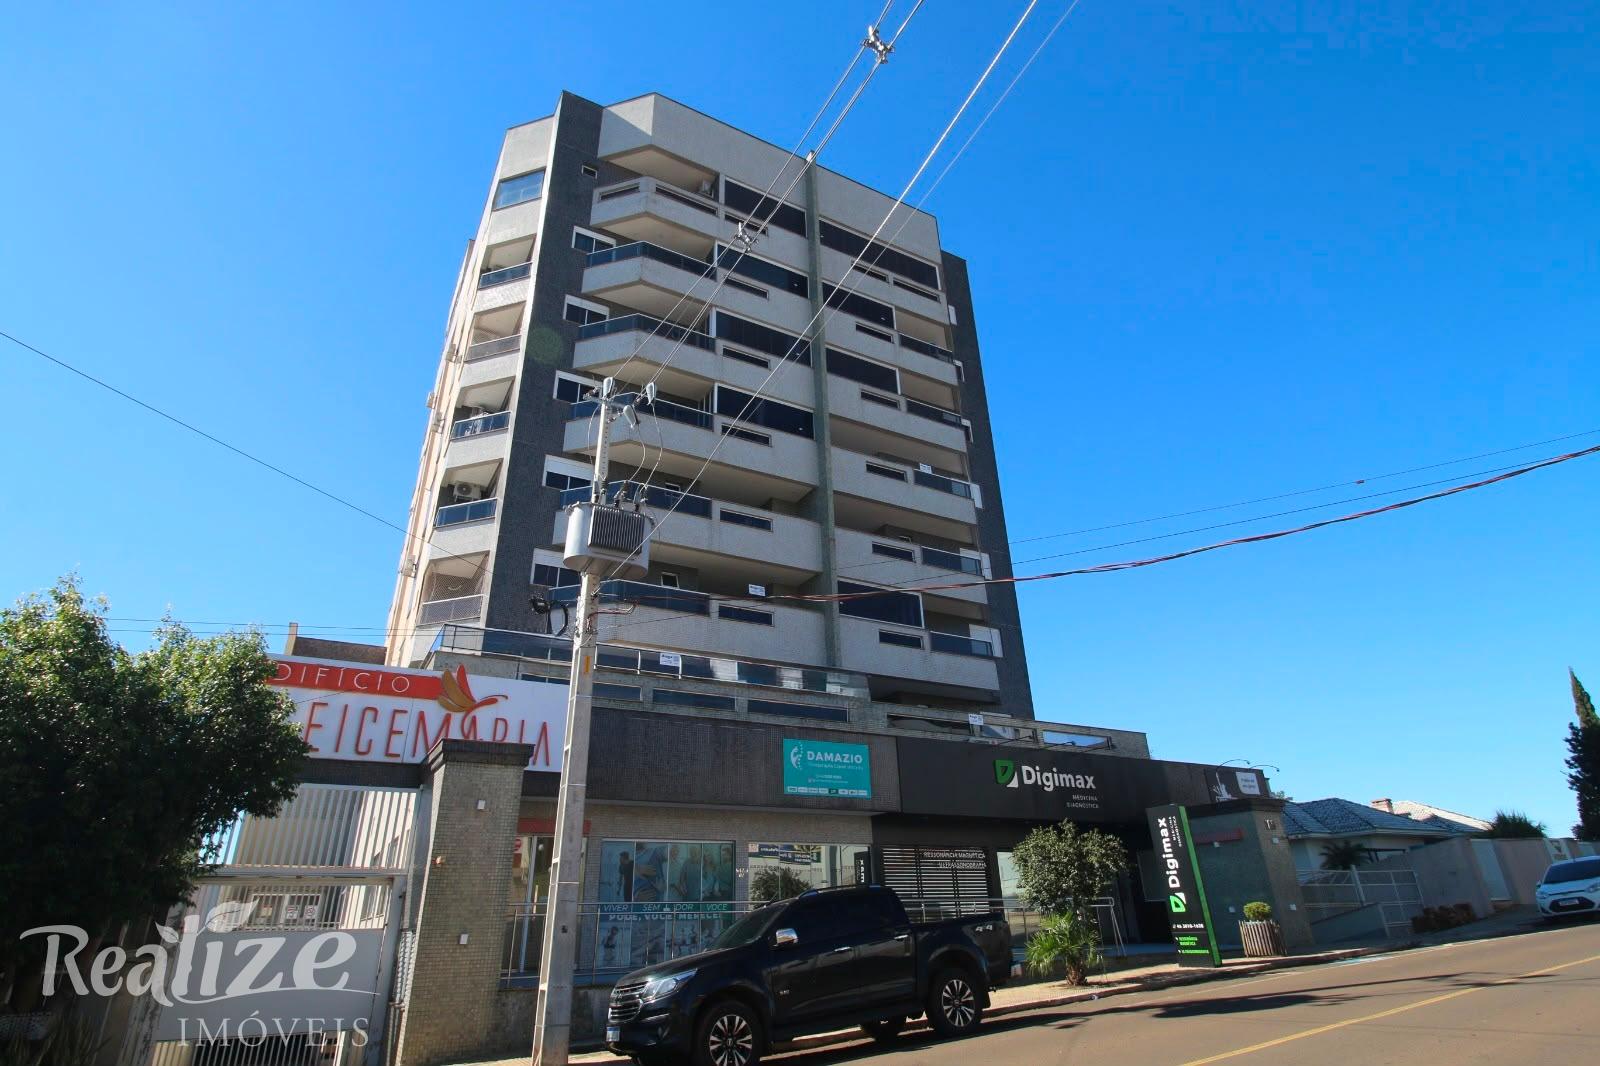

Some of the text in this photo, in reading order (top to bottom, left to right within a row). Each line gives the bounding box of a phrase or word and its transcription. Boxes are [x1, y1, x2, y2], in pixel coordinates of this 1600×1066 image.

[271, 662, 410, 693] DIFÍCIO
[302, 701, 549, 767] EICEMARIA
[806, 750, 863, 764] DAMAZIO
[1021, 765, 1096, 792] Digimax
[1157, 816, 1181, 889] Digimax
[603, 903, 629, 912] VIVER
[642, 903, 660, 912] SEM
